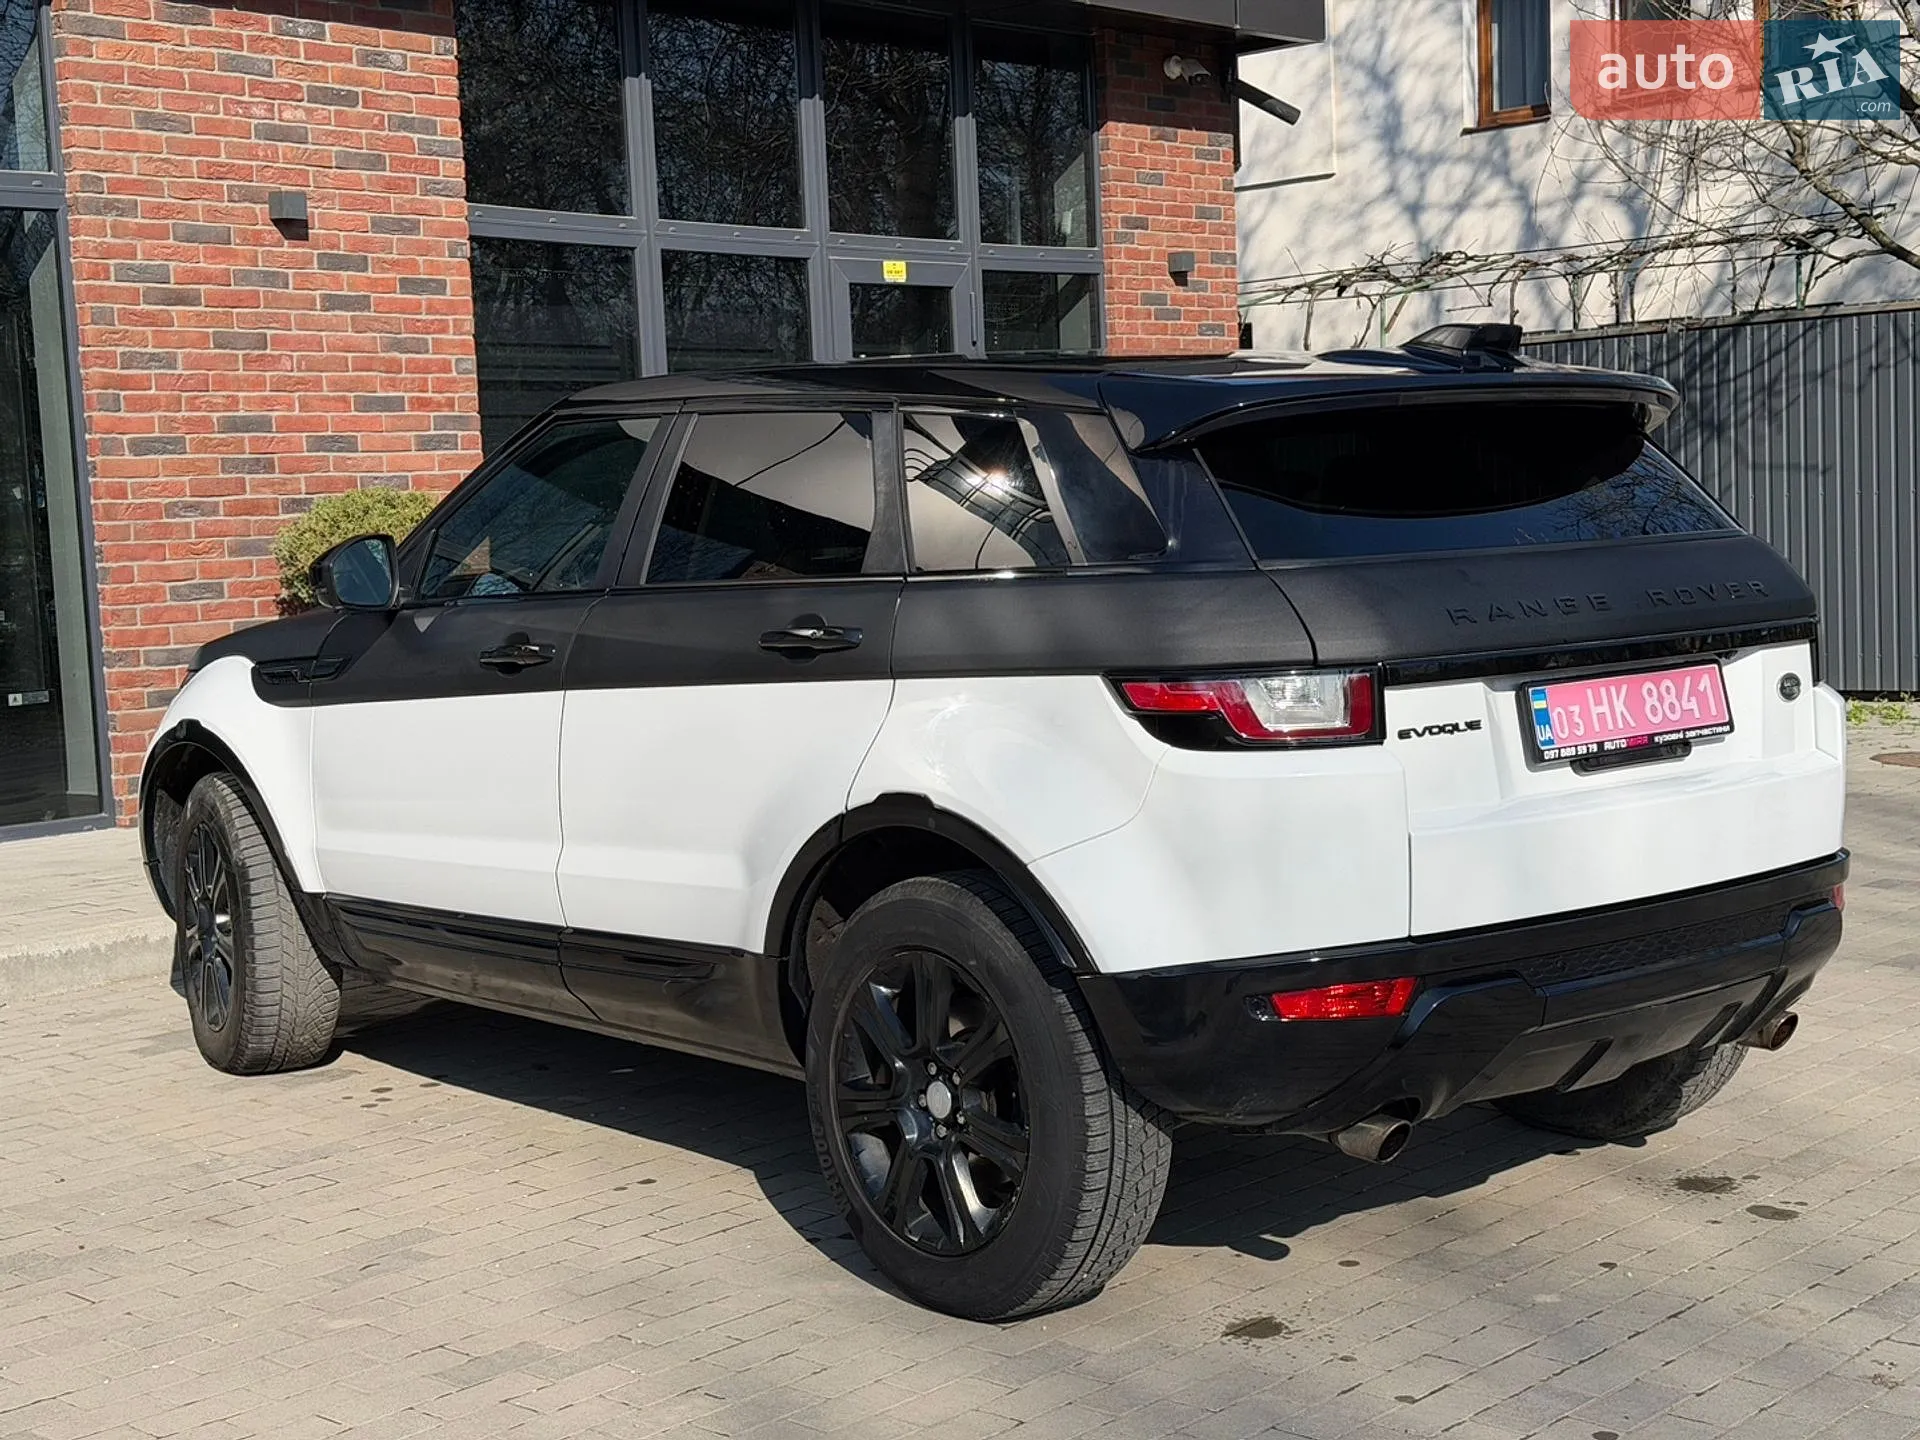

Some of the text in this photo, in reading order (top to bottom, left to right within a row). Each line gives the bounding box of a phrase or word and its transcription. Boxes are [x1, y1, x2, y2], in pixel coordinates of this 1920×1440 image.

[1446, 581, 1769, 626] RANGE ROVER
[1553, 673, 1718, 739] 03 HK 8841
[1397, 719, 1482, 740] EVOQUE
[1536, 724, 1553, 742] UA
